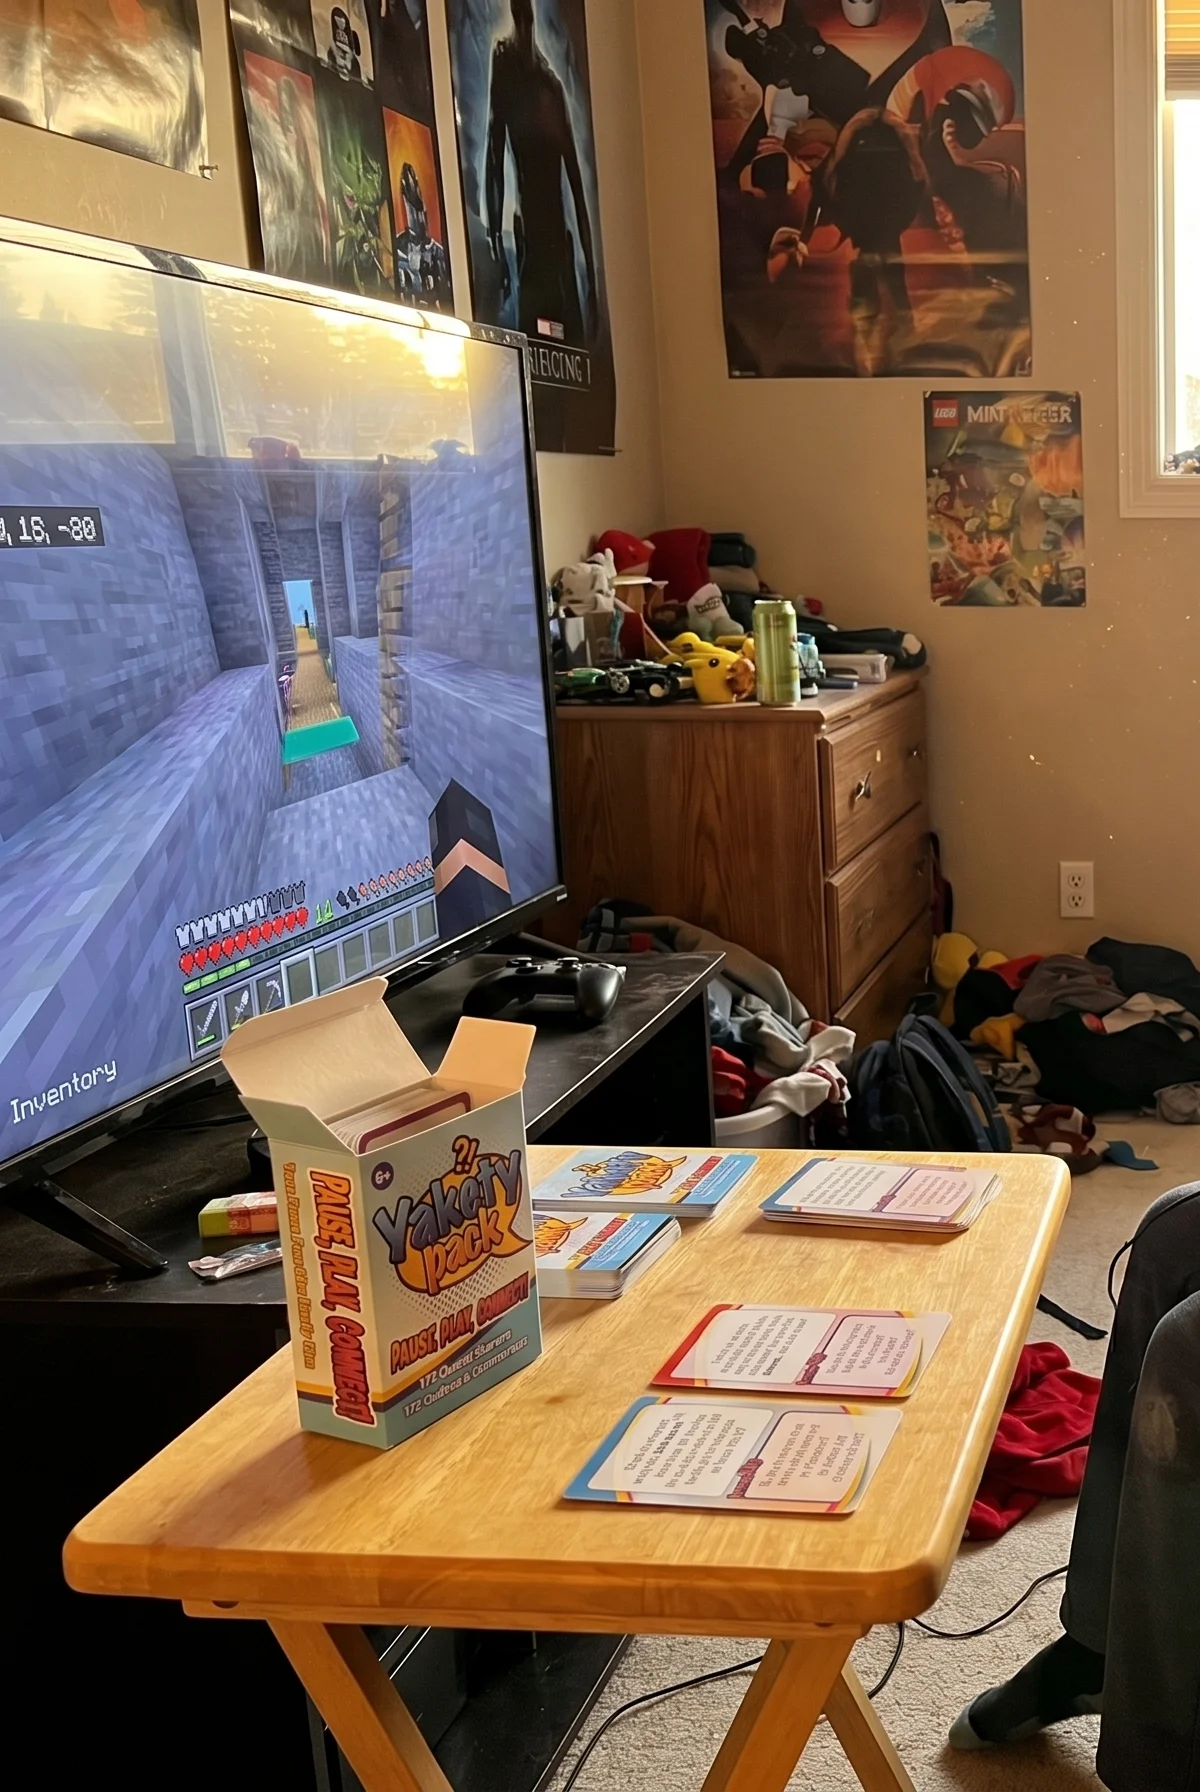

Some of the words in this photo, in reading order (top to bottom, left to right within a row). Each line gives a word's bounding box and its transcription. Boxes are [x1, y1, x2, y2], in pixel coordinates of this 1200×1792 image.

[57, 516, 97, 541] -80
[10, 1060, 117, 1124] Inventory
[309, 1170, 357, 1250] PAUSE,
[372, 1149, 522, 1264] Yakety
[317, 1249, 361, 1314] PLAY,
[420, 1206, 504, 1297] pack
[403, 1402, 423, 1418] 172
[418, 1373, 438, 1390] 172
